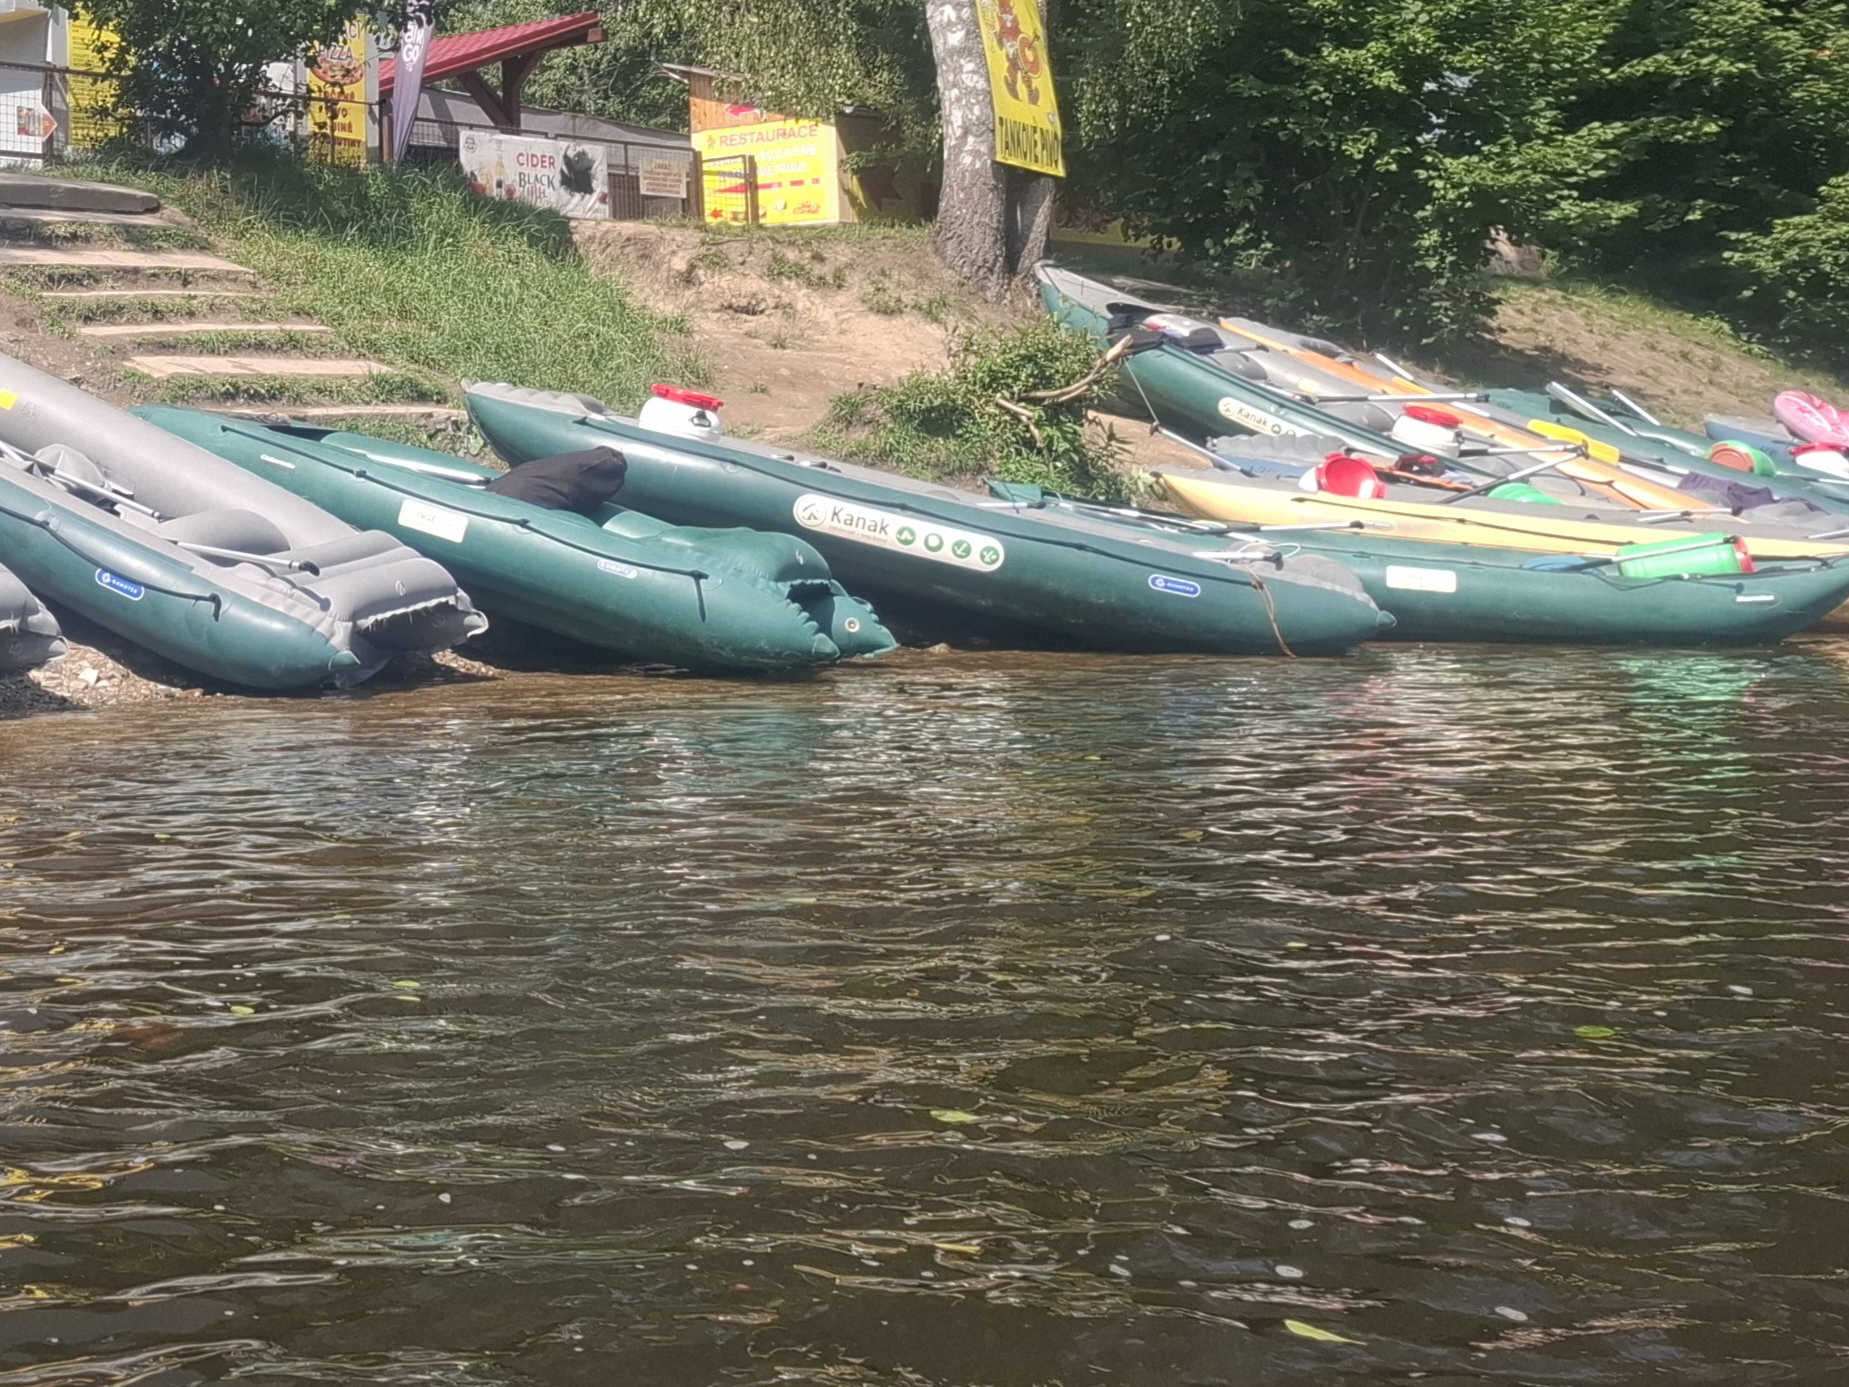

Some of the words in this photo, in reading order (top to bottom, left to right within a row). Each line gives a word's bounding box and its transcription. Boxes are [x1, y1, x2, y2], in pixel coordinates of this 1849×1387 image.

[719, 124, 818, 147] RESTAURACE
[516, 152, 556, 170] CIDER
[519, 171, 556, 191] BLACK
[1237, 405, 1268, 427] Kanak
[830, 505, 890, 536] Kanak
